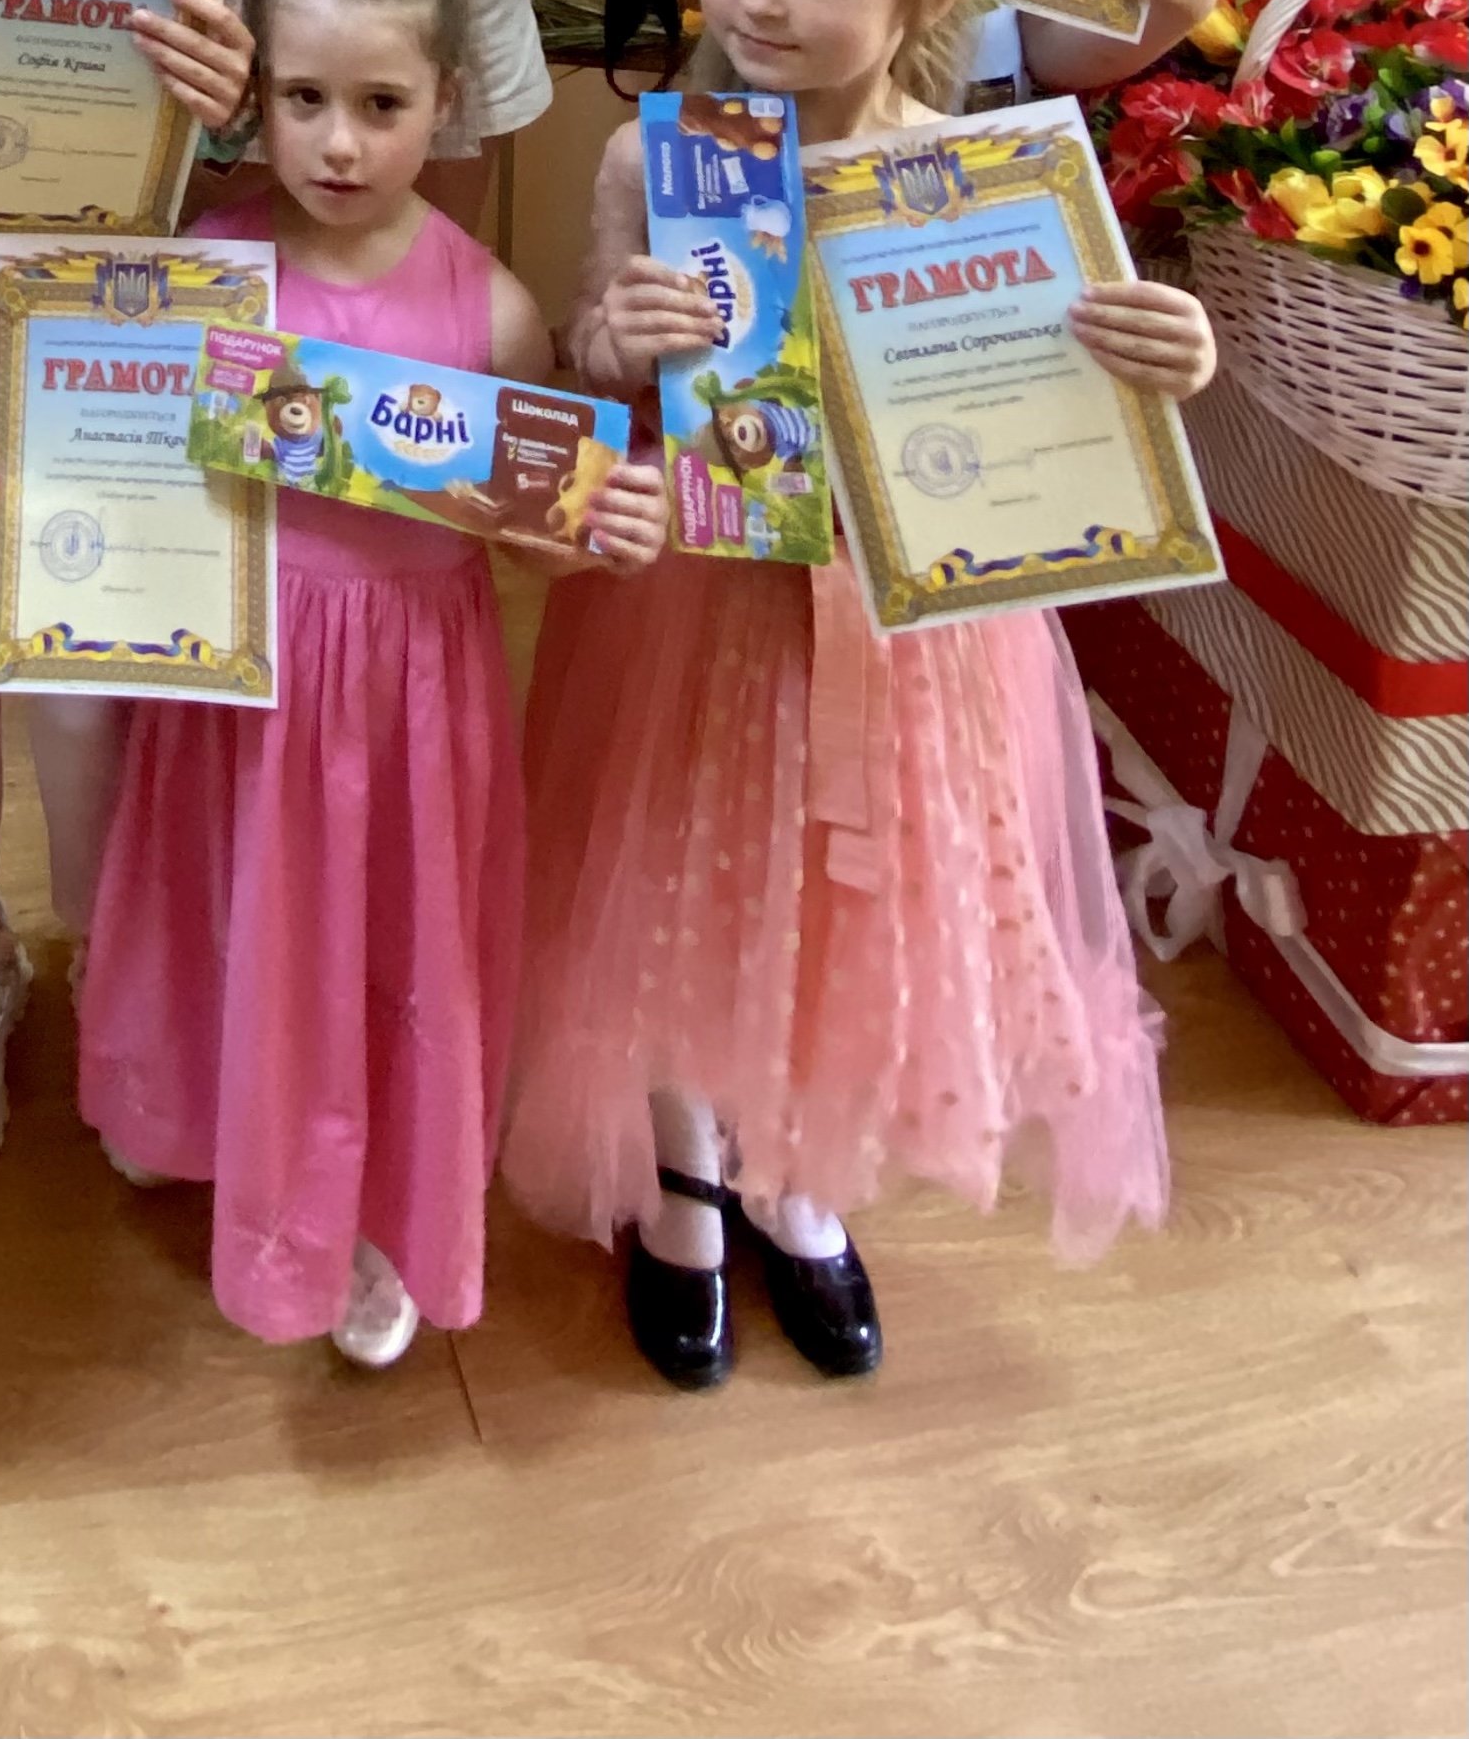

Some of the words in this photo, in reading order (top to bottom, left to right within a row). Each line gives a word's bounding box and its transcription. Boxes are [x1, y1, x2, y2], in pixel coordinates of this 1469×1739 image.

[661, 141, 674, 196] Молоко
[848, 246, 1056, 313] ГРАМОТА
[210, 331, 282, 356] ПОДАРУНОК
[884, 342, 958, 364] Світлана
[961, 323, 1062, 352] Сорочинська
[42, 357, 196, 395] ГРАМОТ
[371, 393, 470, 444] Барні
[512, 399, 579, 427] Шоколад
[69, 428, 142, 444] Анастасія
[680, 455, 696, 544] ПОДАРУНОК
